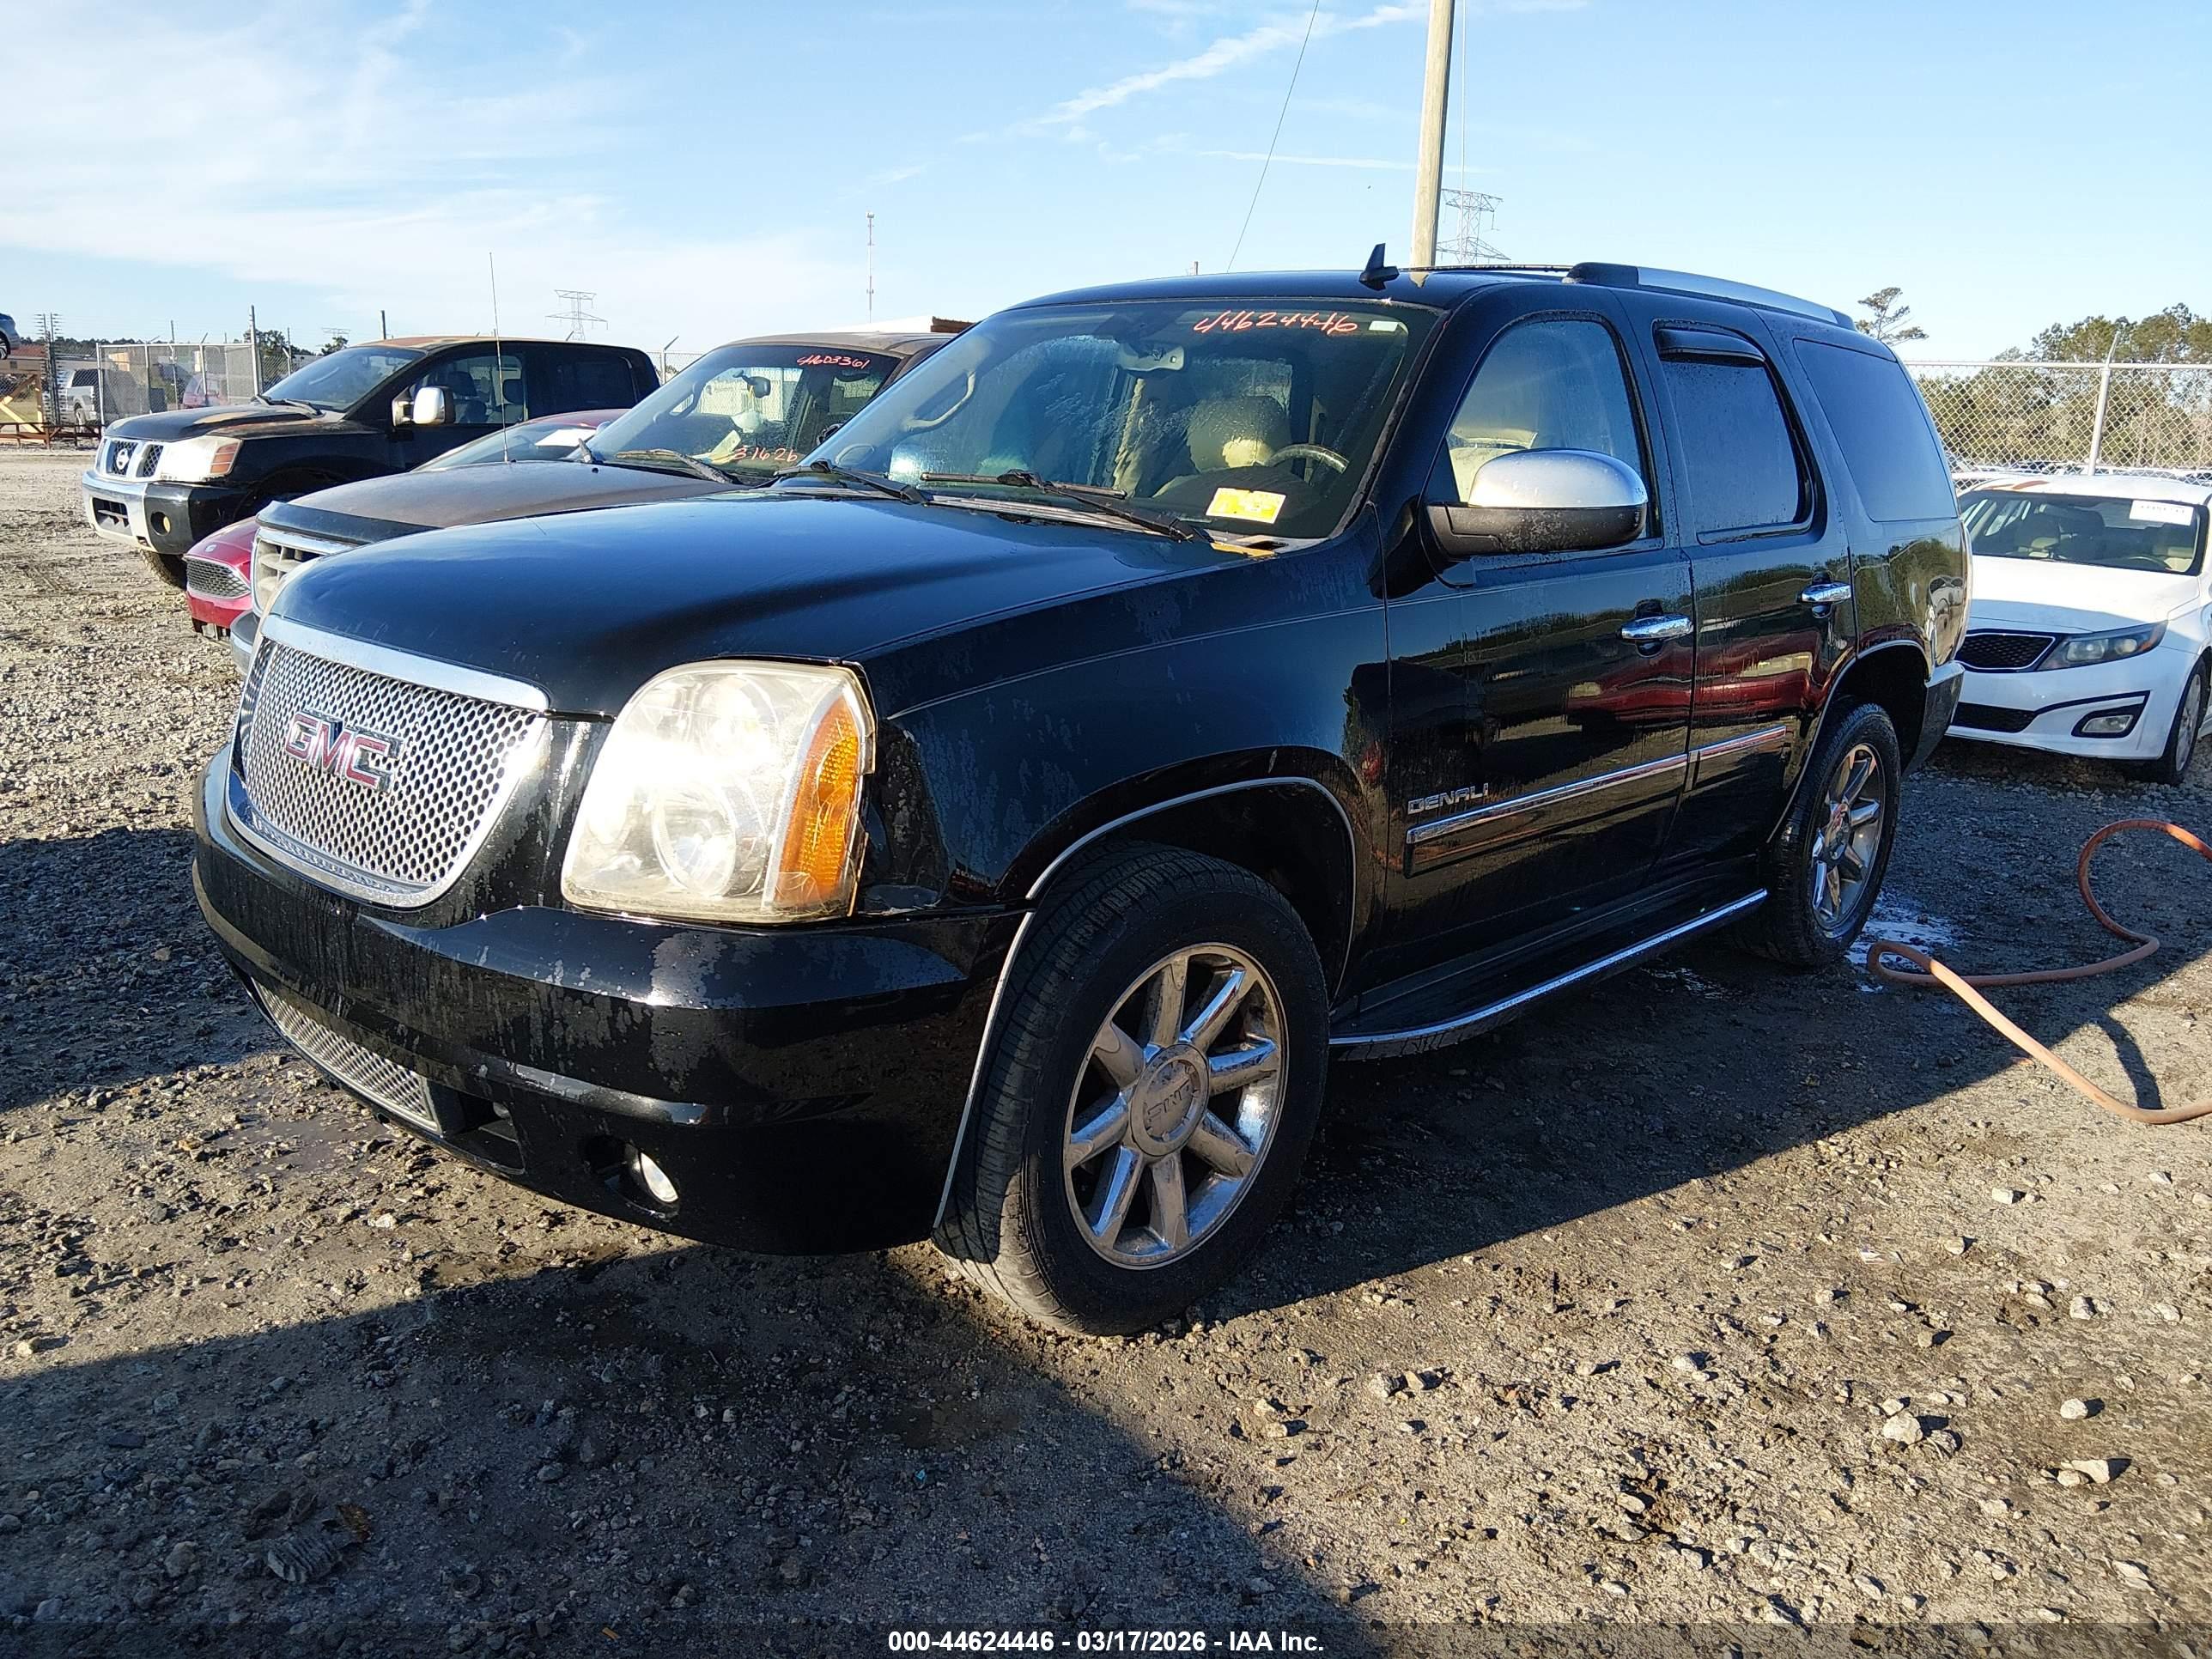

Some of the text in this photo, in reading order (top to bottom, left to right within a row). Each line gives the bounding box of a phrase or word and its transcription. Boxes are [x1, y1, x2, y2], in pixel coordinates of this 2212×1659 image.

[1194, 310, 1358, 335] 44624446
[284, 711, 399, 792] GMC
[1407, 782, 1489, 815] DENALI
